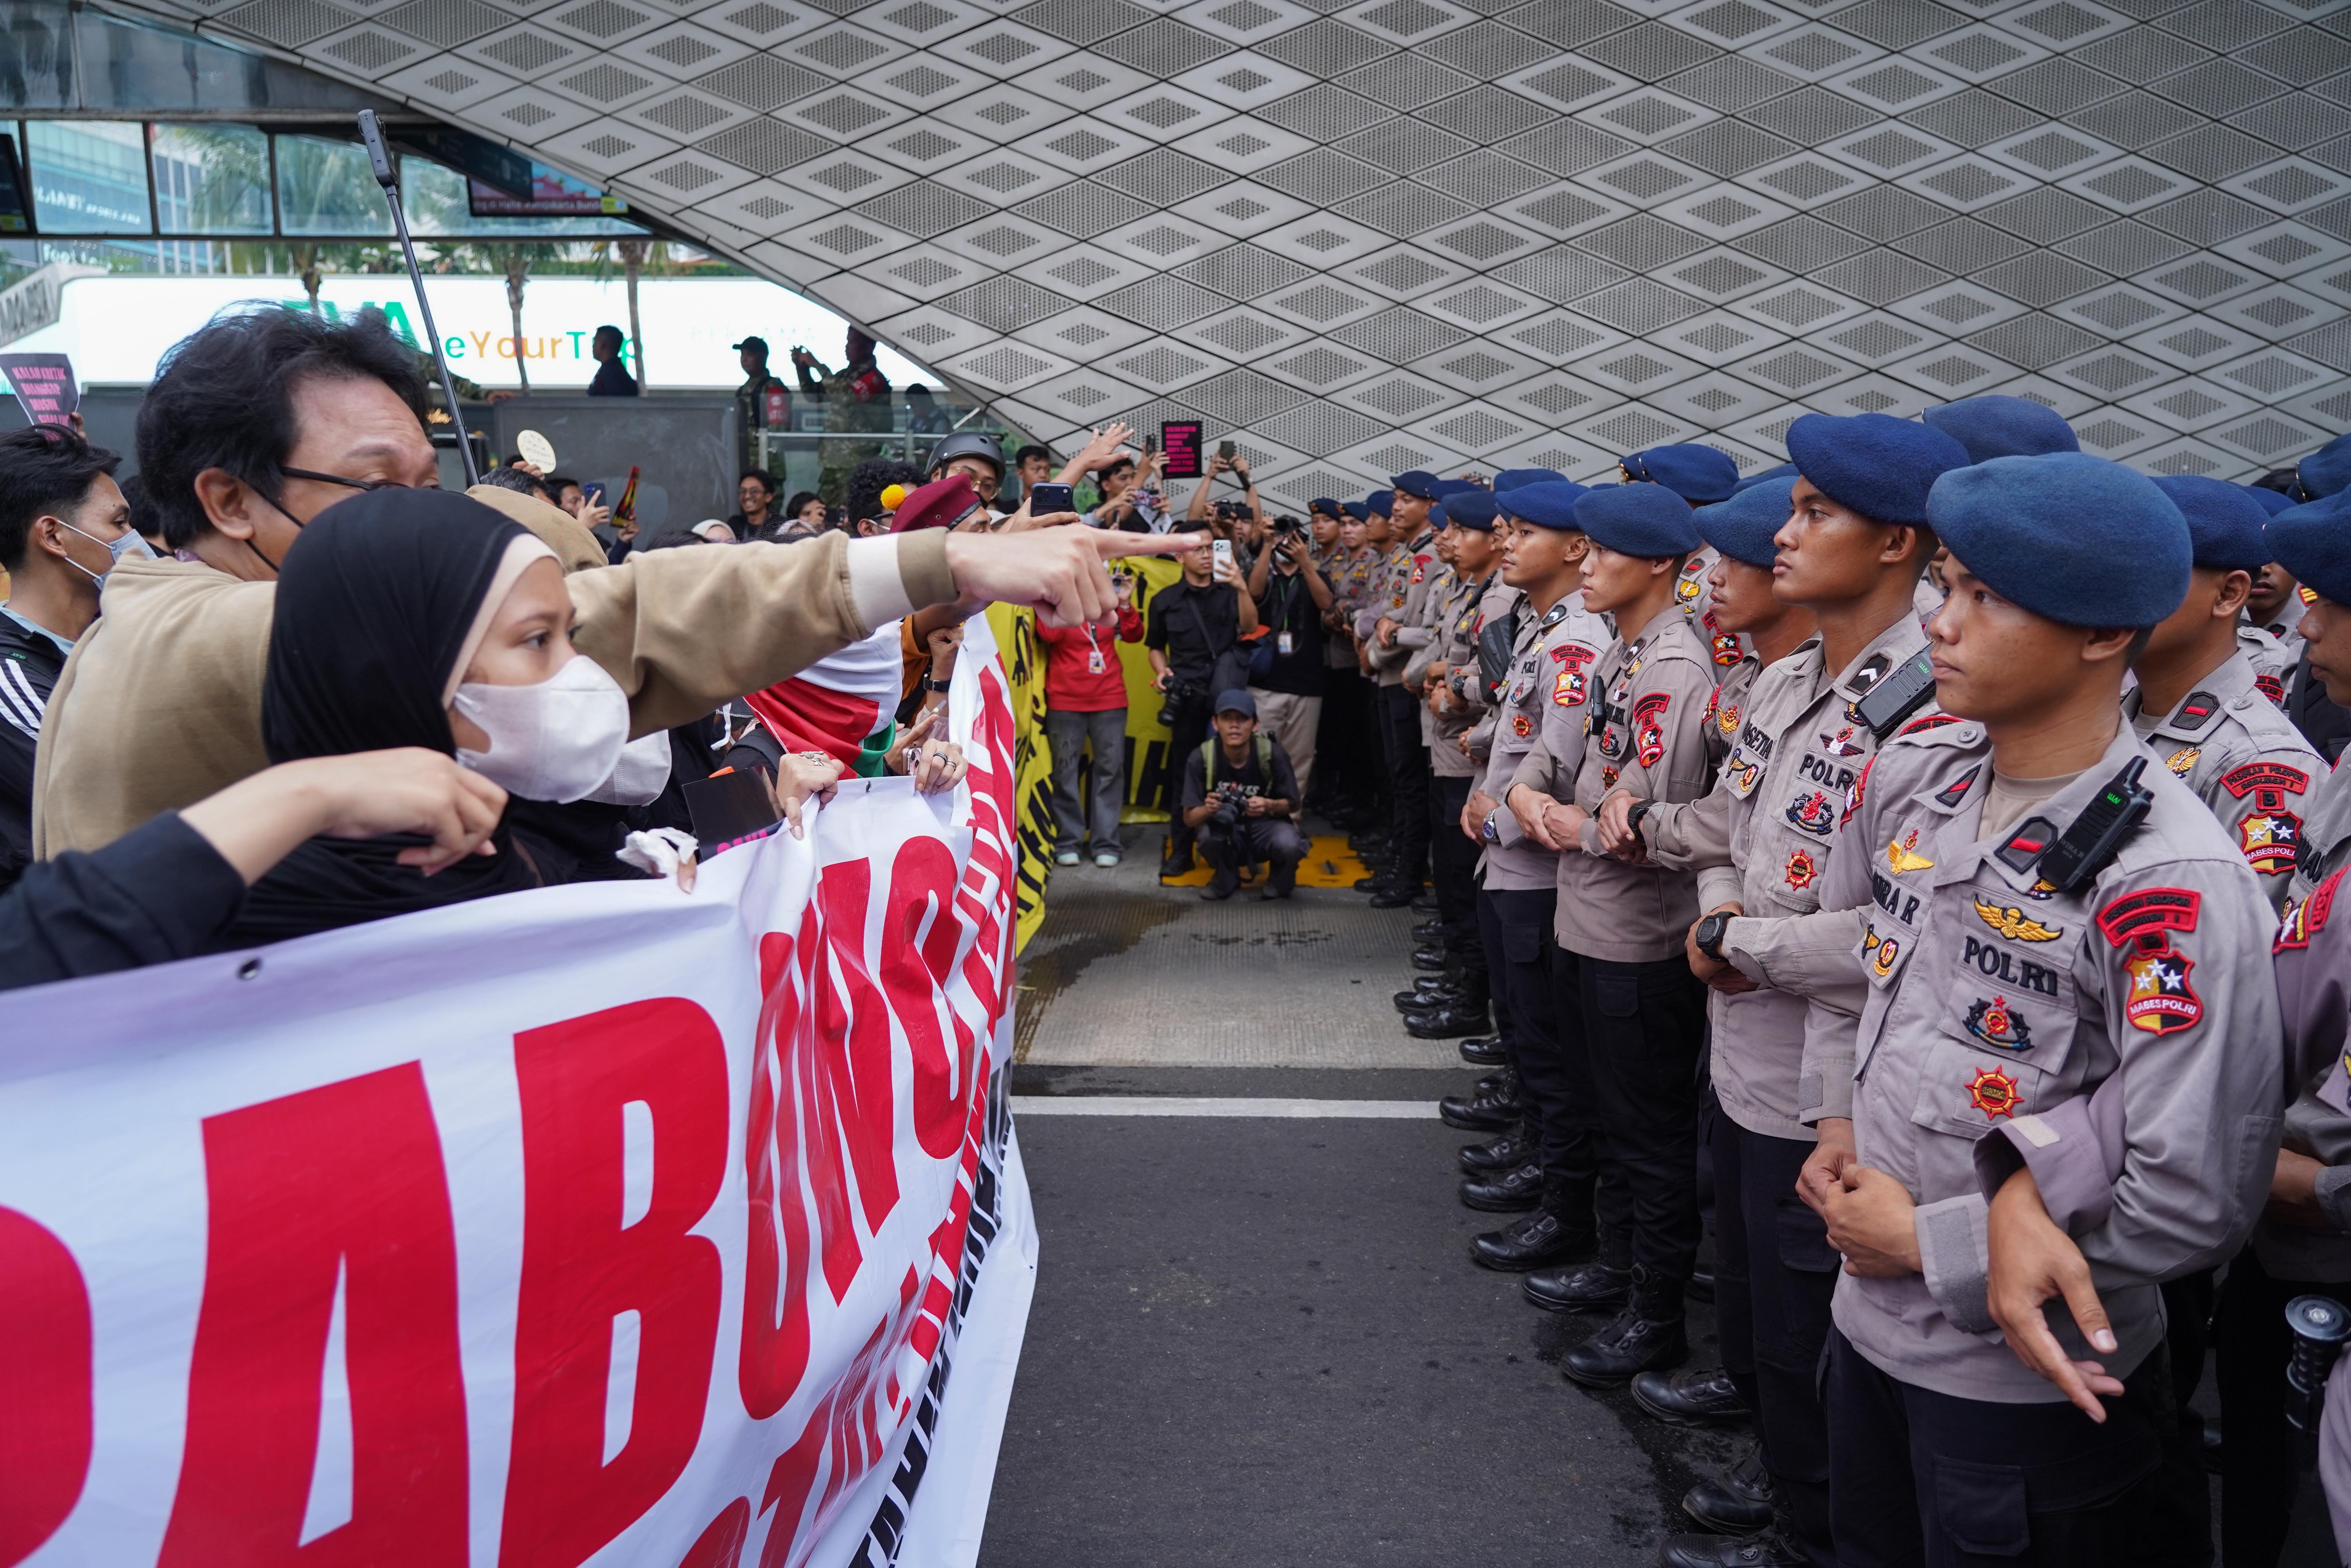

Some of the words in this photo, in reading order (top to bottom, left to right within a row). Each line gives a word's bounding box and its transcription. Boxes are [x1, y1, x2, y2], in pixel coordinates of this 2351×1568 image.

[1799, 753, 1854, 791] POLR
[2227, 766, 2264, 785] PASUKAN
[2269, 766, 2304, 783] PELOPOR
[2263, 791, 2277, 806] B
[1900, 895, 1920, 925] R
[2104, 899, 2144, 924] PASUKAN
[2145, 895, 2190, 907] PELOPOR
[1963, 935, 2058, 996] POLRI
[2130, 998, 2161, 1015] MABES
[2162, 999, 2197, 1015] POLRI
[1981, 1086, 2006, 1098] BRIMOB
